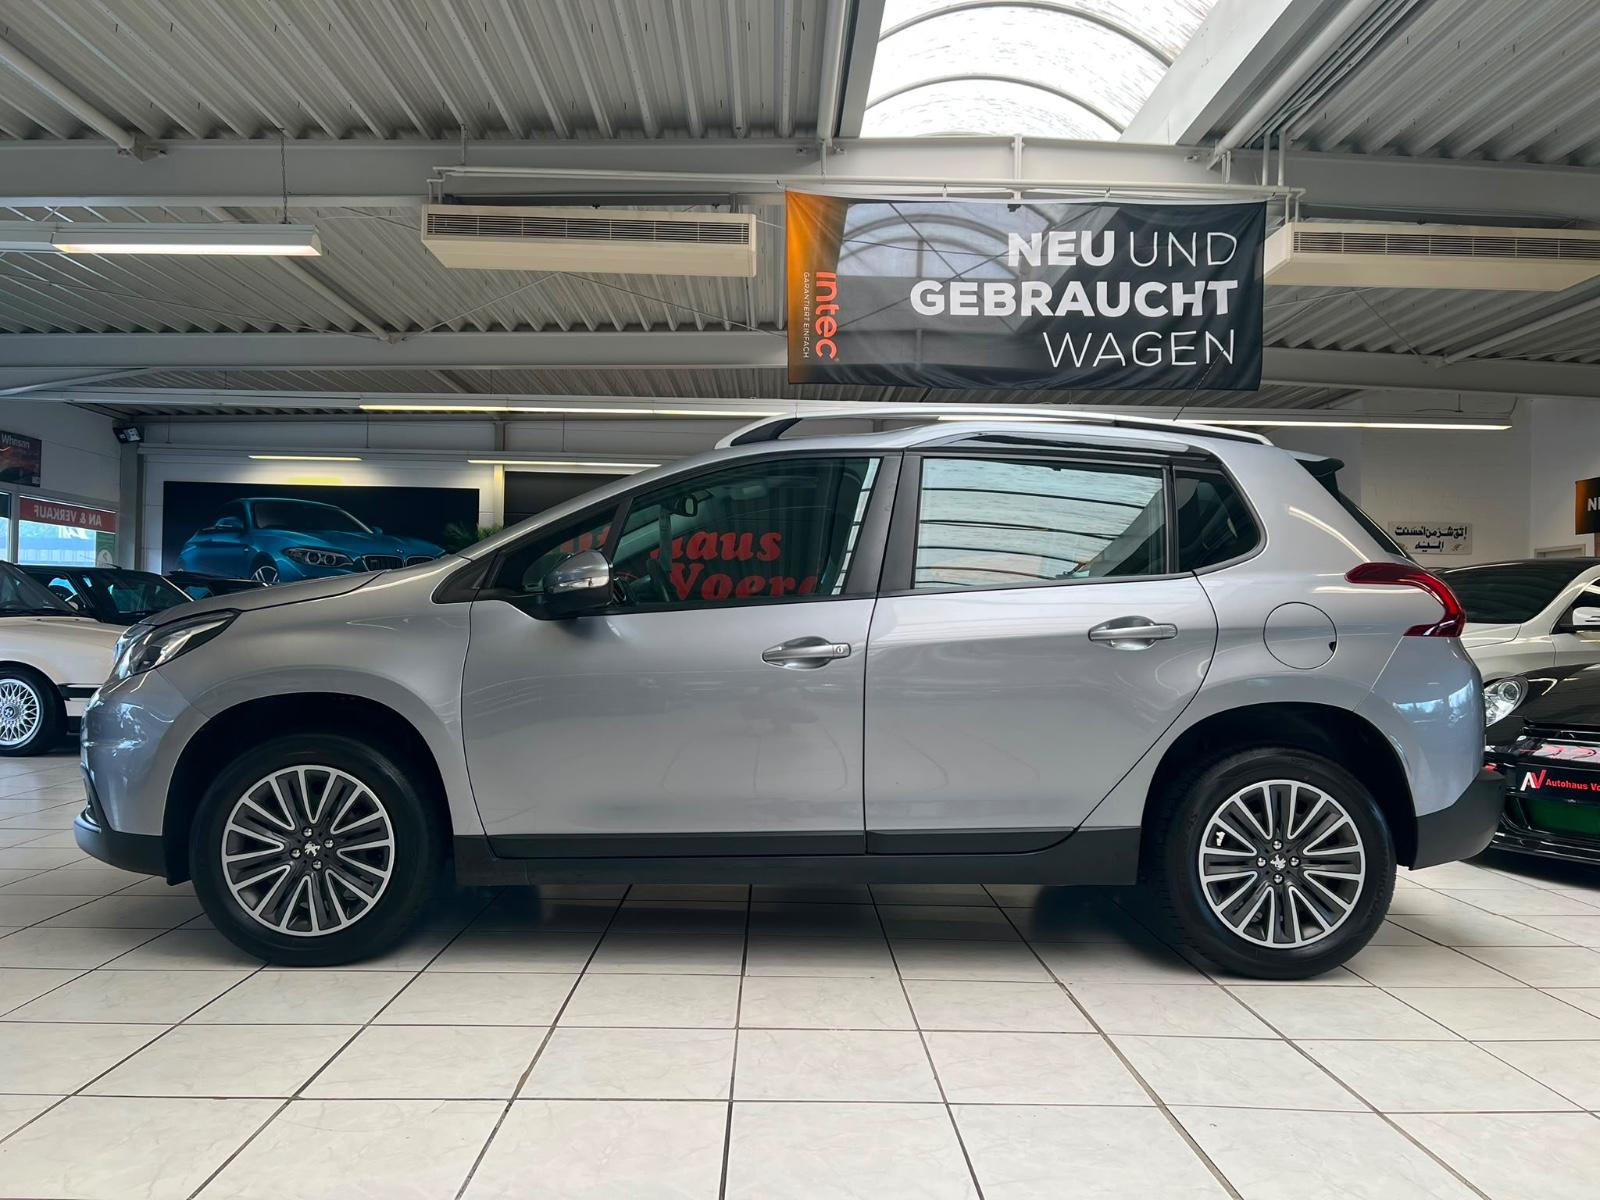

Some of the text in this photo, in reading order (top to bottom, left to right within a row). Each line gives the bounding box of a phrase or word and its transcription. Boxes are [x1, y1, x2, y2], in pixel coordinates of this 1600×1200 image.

[1008, 230, 1238, 267] NEU UND
[910, 280, 1238, 318] GEBRAUCHT
[1043, 329, 1235, 368] WAGEN
[1545, 778, 1588, 790] Autohaus
